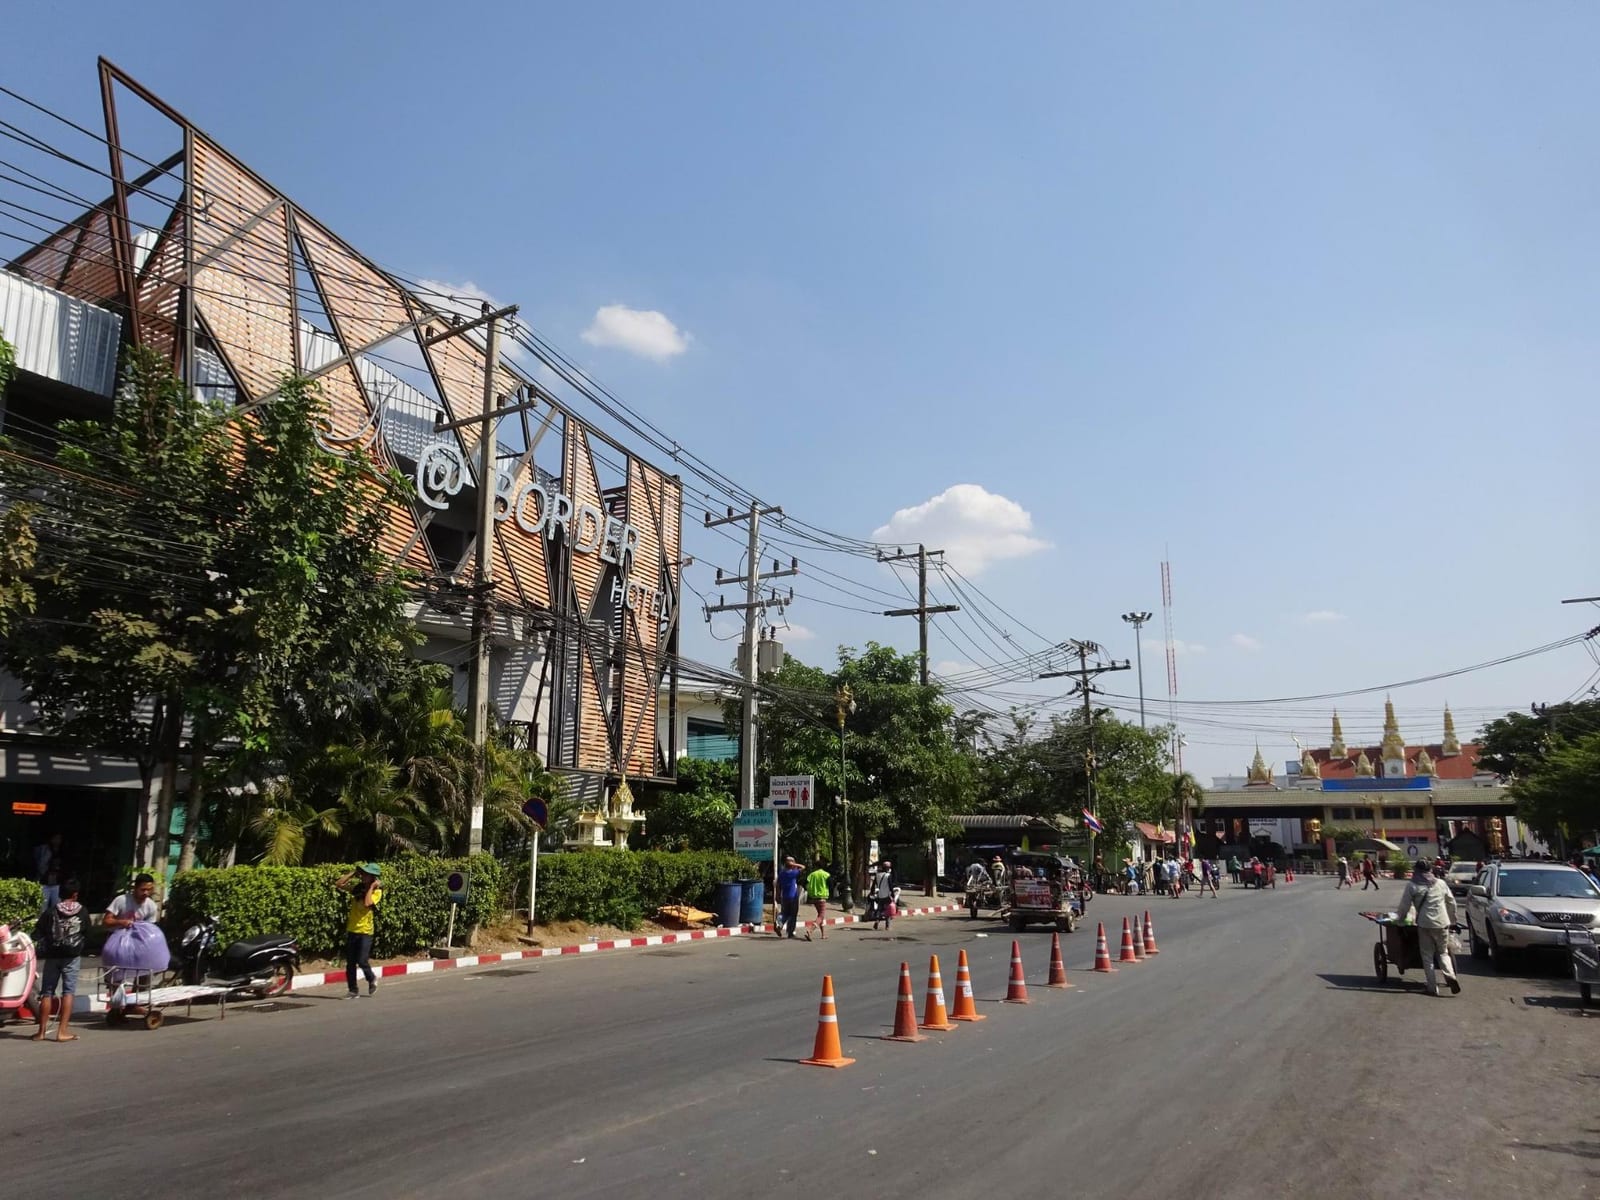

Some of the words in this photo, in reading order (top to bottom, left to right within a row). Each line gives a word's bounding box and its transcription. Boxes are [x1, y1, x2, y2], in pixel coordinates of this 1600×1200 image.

[417, 443, 467, 510] @
[494, 468, 640, 570] BORDER
[610, 575, 670, 621] HOTEL
